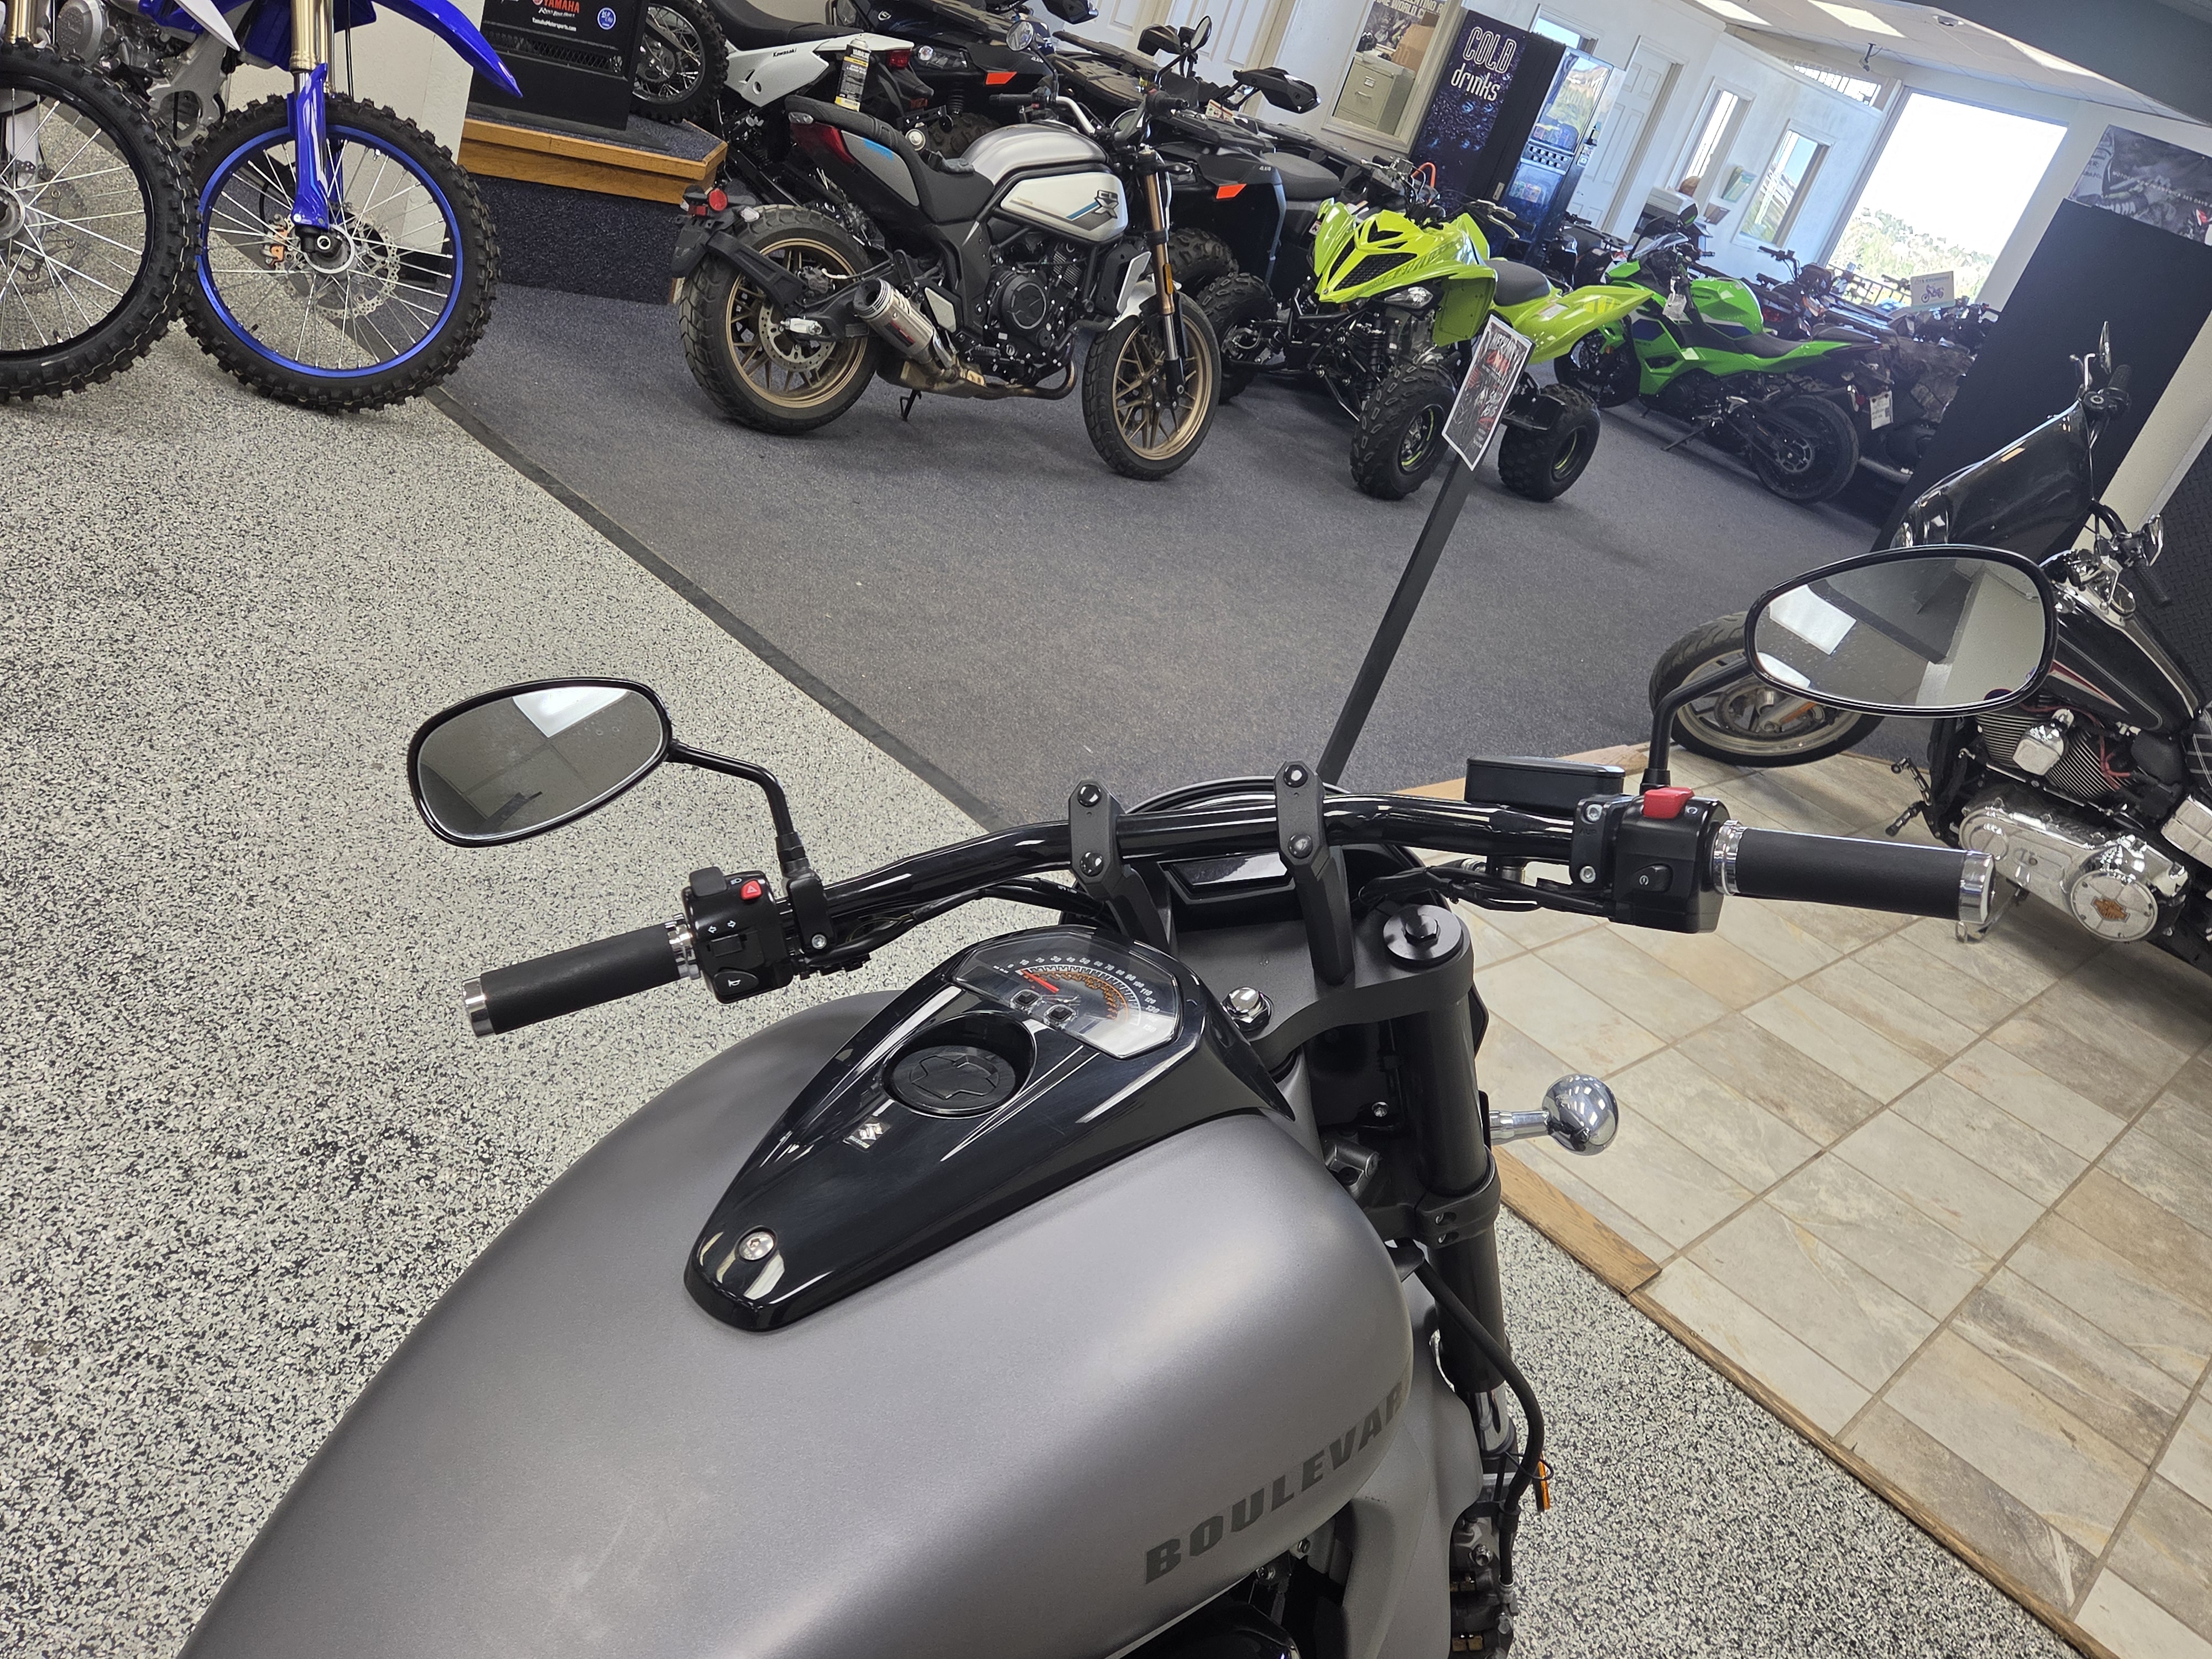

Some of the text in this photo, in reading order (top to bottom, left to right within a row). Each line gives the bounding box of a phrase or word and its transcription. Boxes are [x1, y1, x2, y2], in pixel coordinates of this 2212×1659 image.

[543, 0, 580, 13] YAMAHA
[773, 48, 797, 58] Kawasaki
[1463, 27, 1517, 74] COLD
[1451, 62, 1501, 101] drinks
[1145, 1005, 1160, 1014] 130
[1142, 1024, 1157, 1033] 150
